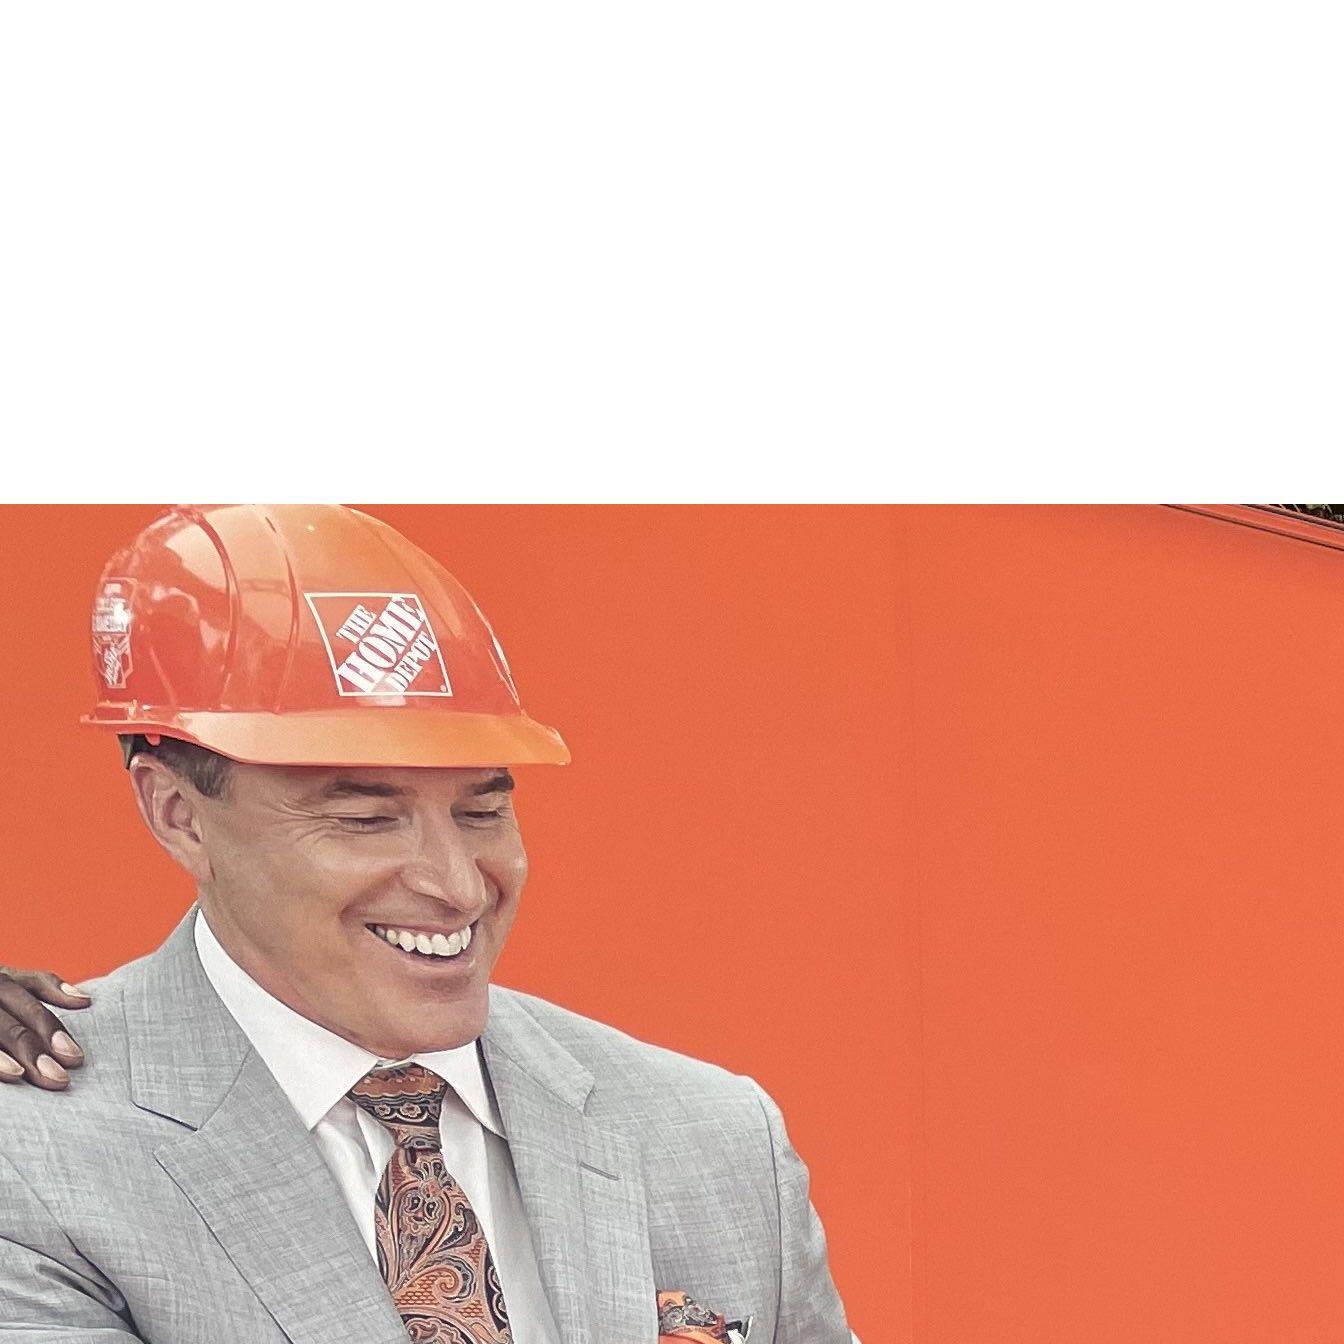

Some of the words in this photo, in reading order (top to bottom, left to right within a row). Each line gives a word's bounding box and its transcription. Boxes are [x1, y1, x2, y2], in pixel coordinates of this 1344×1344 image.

[336, 604, 377, 645] THE
[337, 596, 426, 694] HOME
[383, 630, 437, 693] DEPOT
